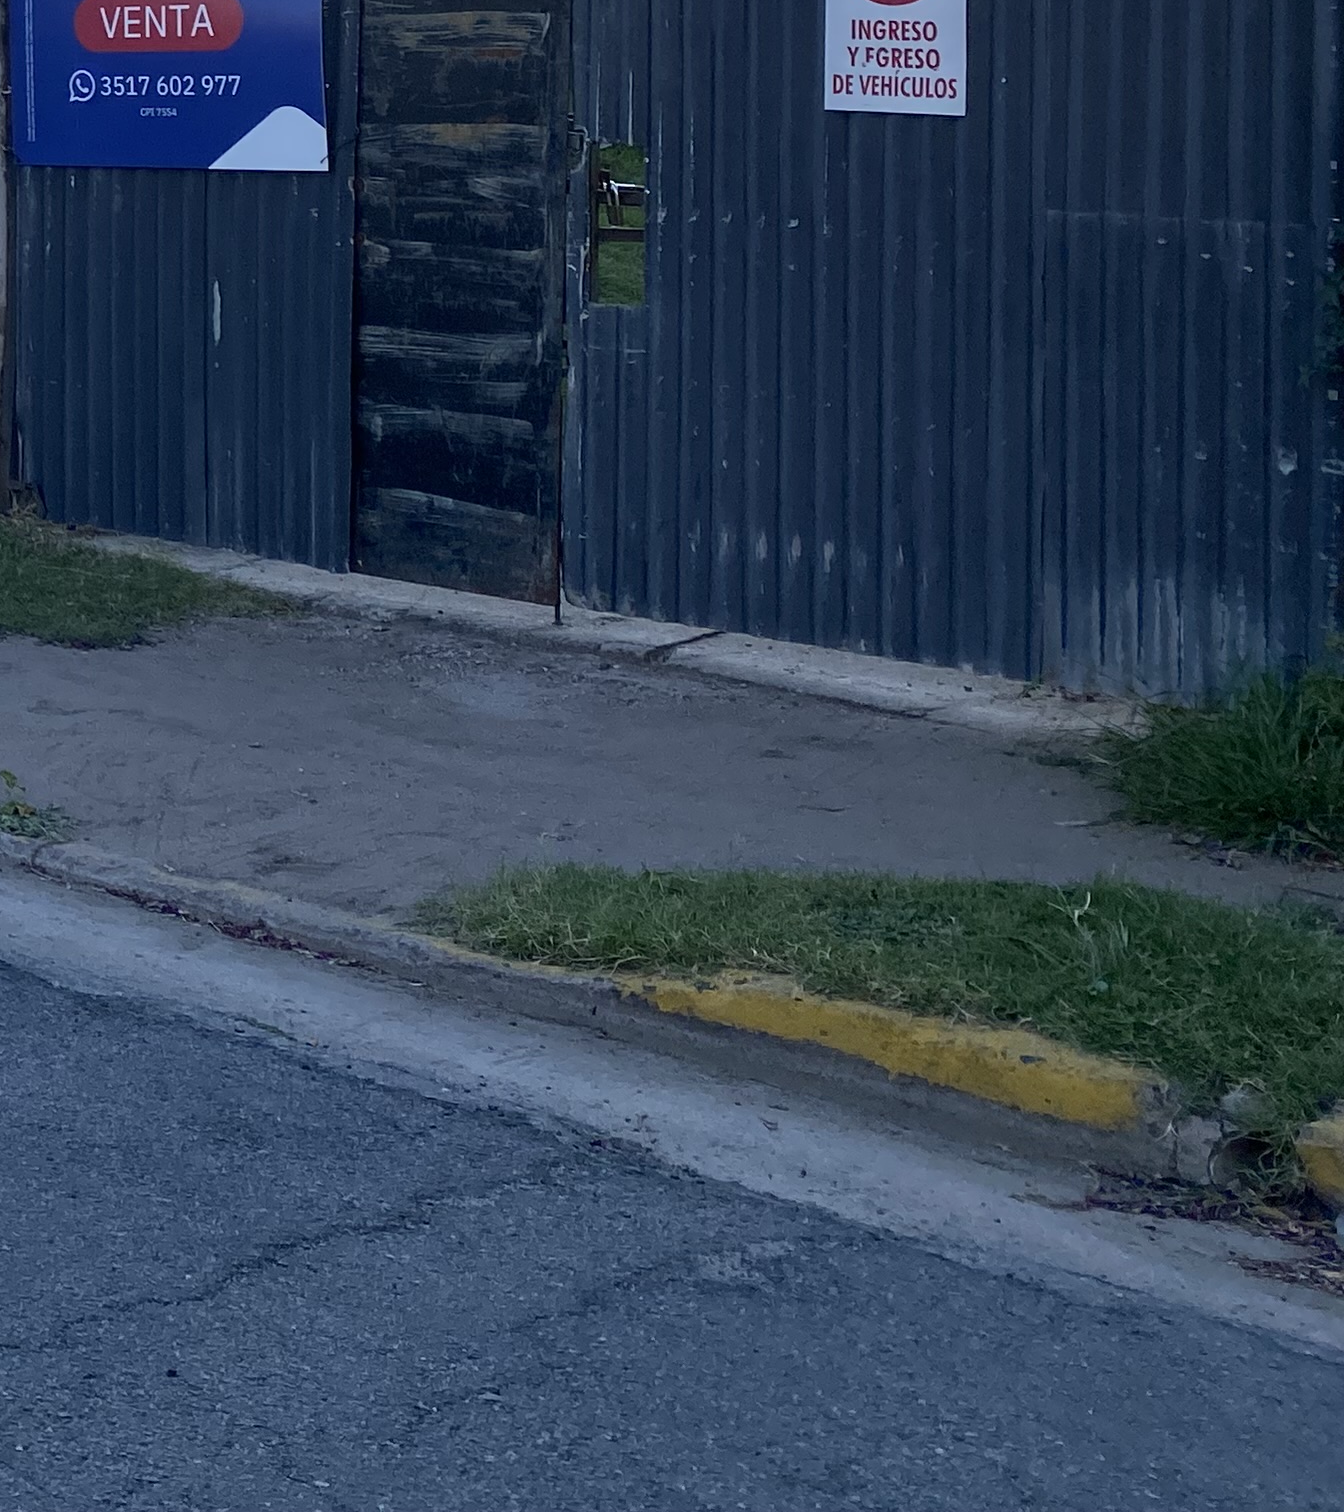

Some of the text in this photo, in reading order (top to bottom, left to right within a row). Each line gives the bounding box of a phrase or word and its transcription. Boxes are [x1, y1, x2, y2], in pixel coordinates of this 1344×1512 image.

[100, 4, 215, 38] VENTA
[851, 19, 938, 41] INGRESO
[847, 46, 860, 67] Y
[100, 75, 241, 96] 3517 602 977
[832, 70, 957, 99] DE VEHÍCULOS
